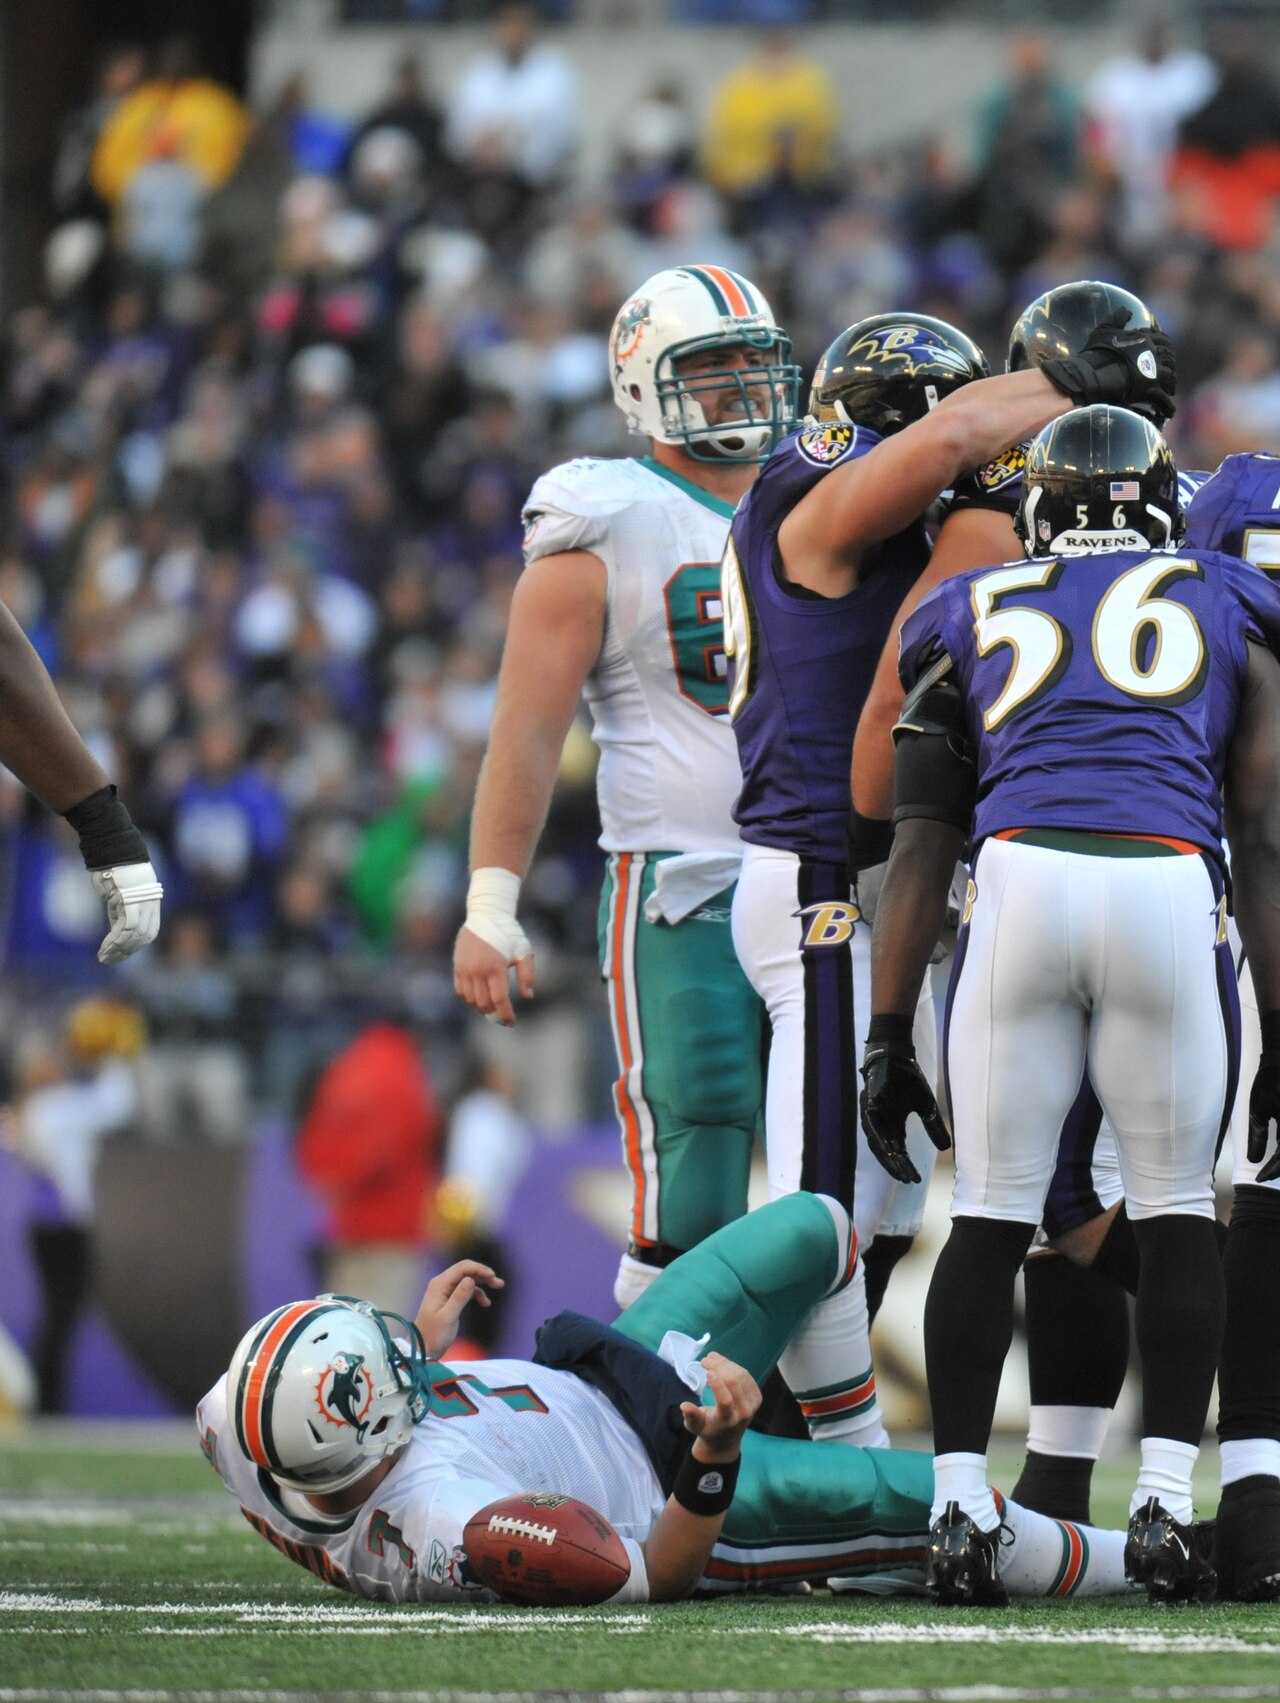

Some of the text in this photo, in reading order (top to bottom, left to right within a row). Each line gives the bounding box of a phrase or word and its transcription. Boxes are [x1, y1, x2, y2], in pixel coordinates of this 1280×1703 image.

[1064, 535, 1138, 549] RAVENS
[970, 556, 1212, 734] 56
[789, 901, 861, 946] B
